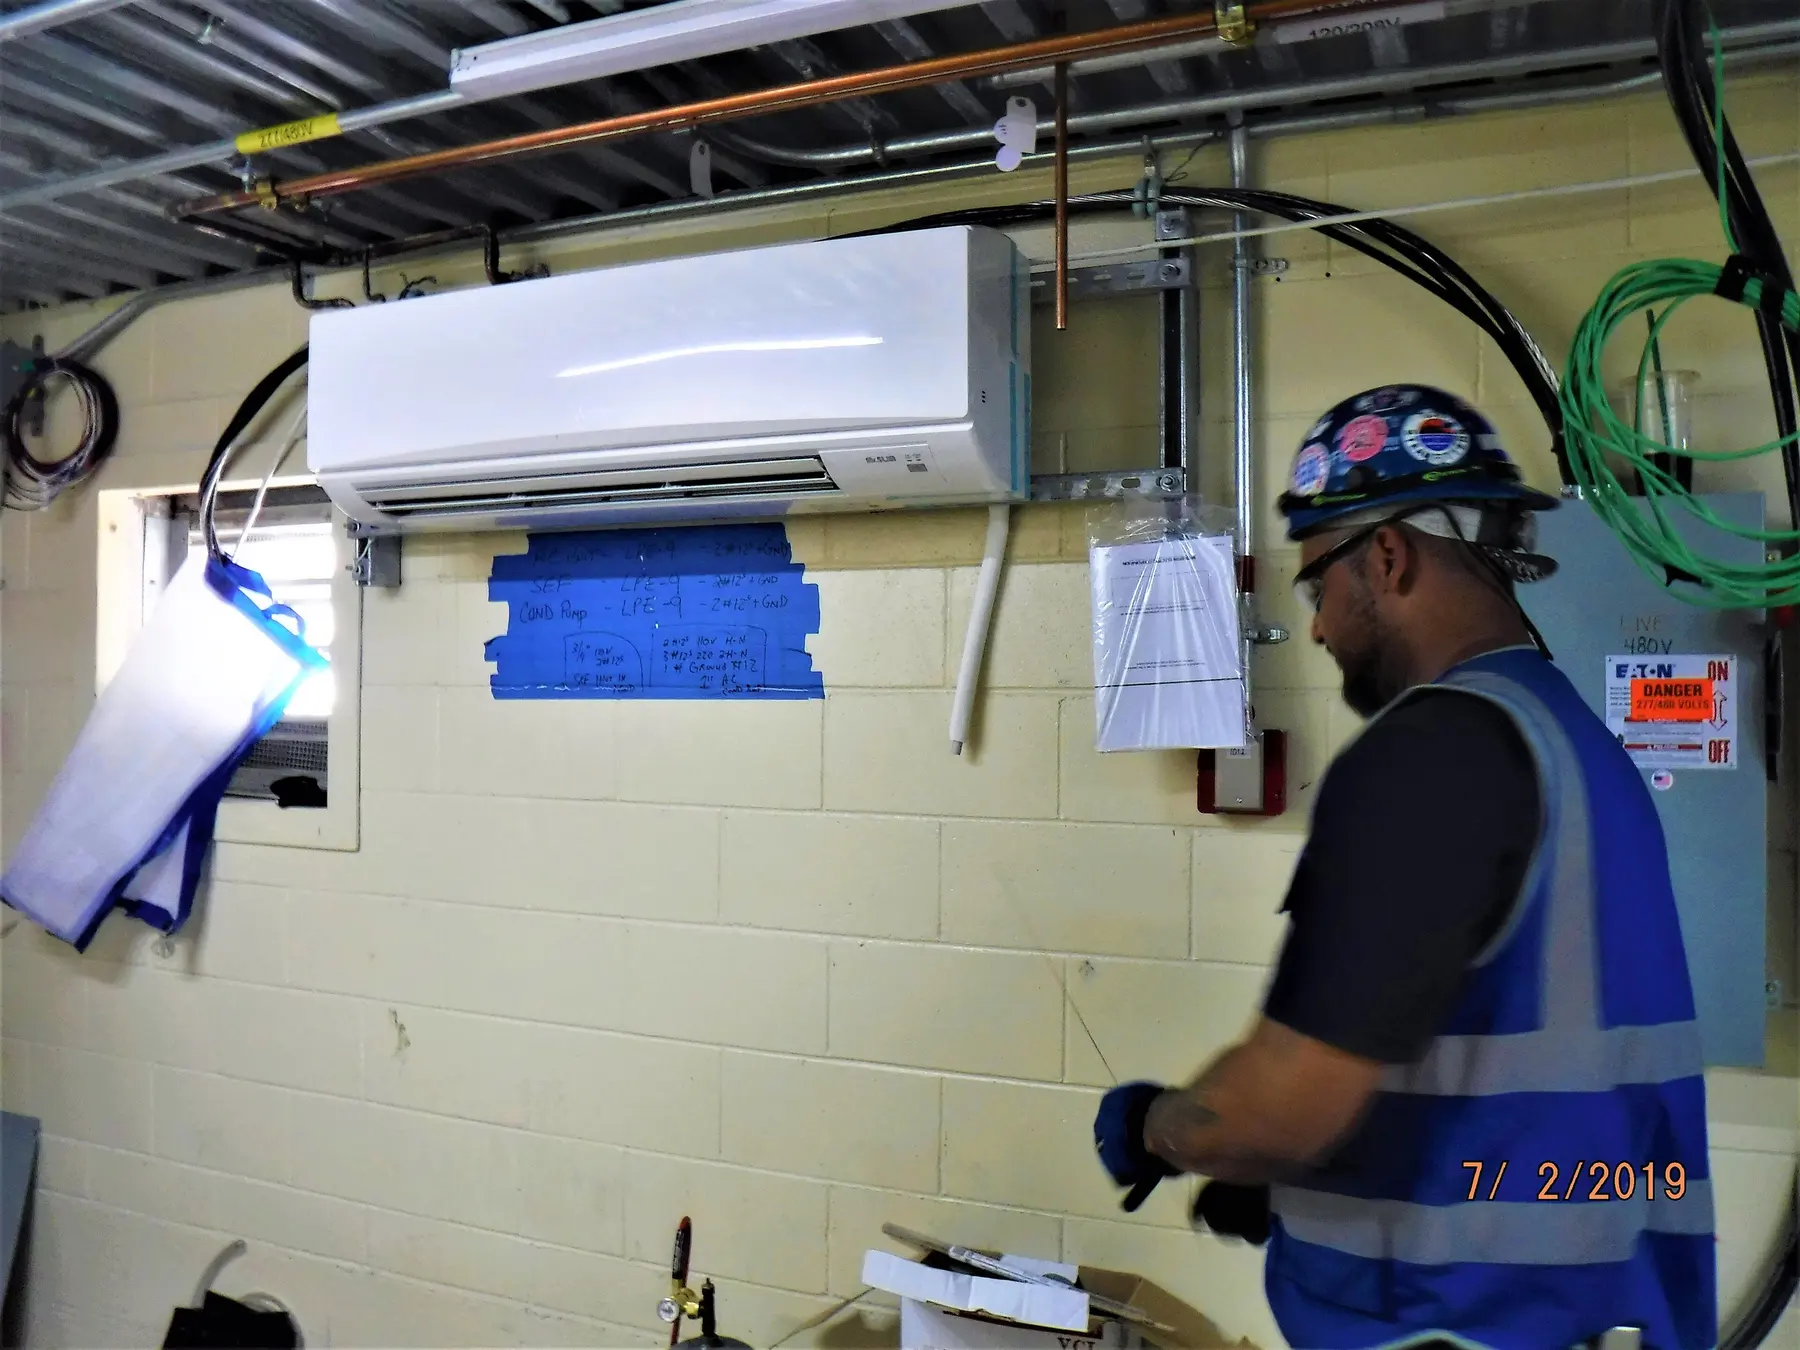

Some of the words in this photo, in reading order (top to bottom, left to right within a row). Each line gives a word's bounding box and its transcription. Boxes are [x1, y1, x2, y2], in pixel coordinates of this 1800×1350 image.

[1623, 635, 1673, 655] 480V
[1707, 660, 1729, 682] ON
[1643, 683, 1704, 698] DANGER
[1678, 699, 1710, 710] VOLTS
[1708, 739, 1732, 765] OFF
